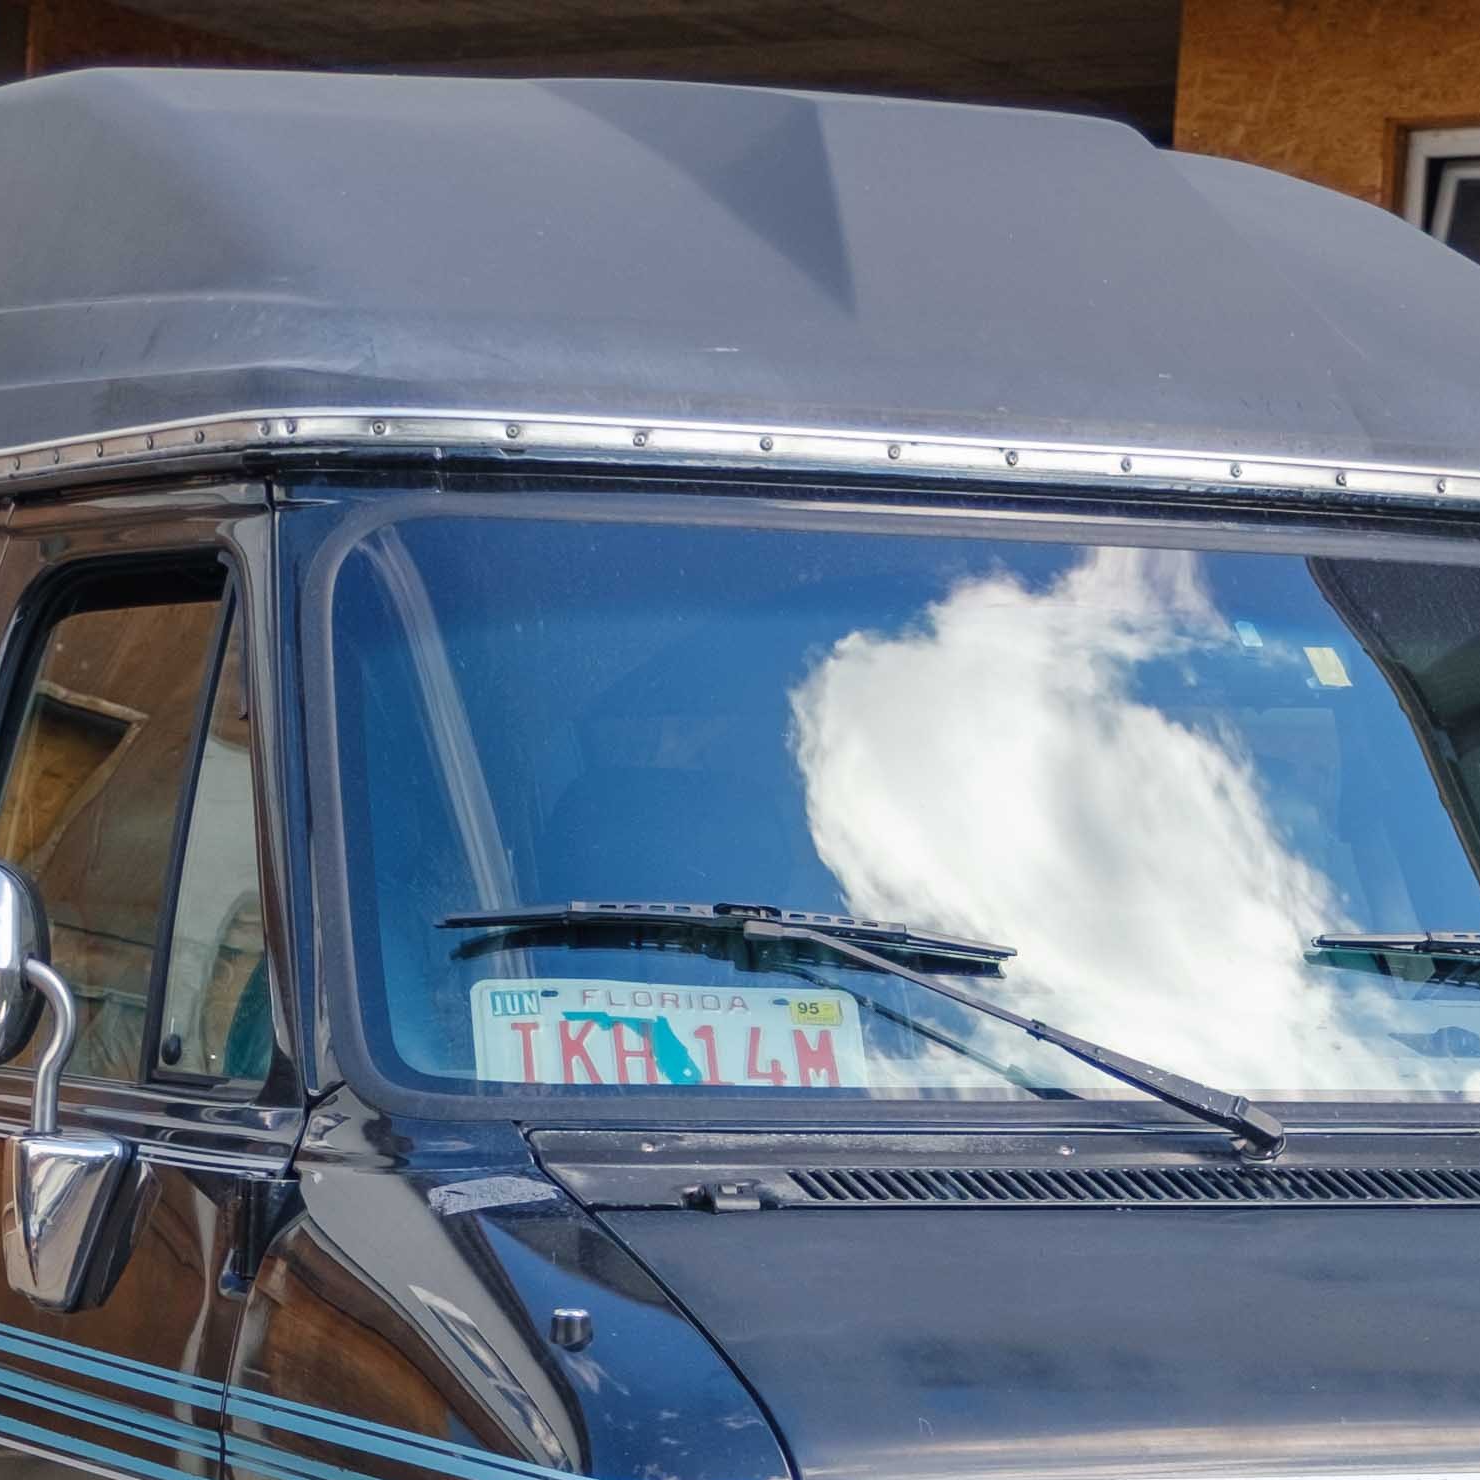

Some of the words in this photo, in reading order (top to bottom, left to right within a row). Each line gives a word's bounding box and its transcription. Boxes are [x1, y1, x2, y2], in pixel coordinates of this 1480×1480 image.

[494, 992, 539, 1015] JUN
[580, 988, 749, 1012] FLORIDA
[797, 1001, 820, 1015] 95
